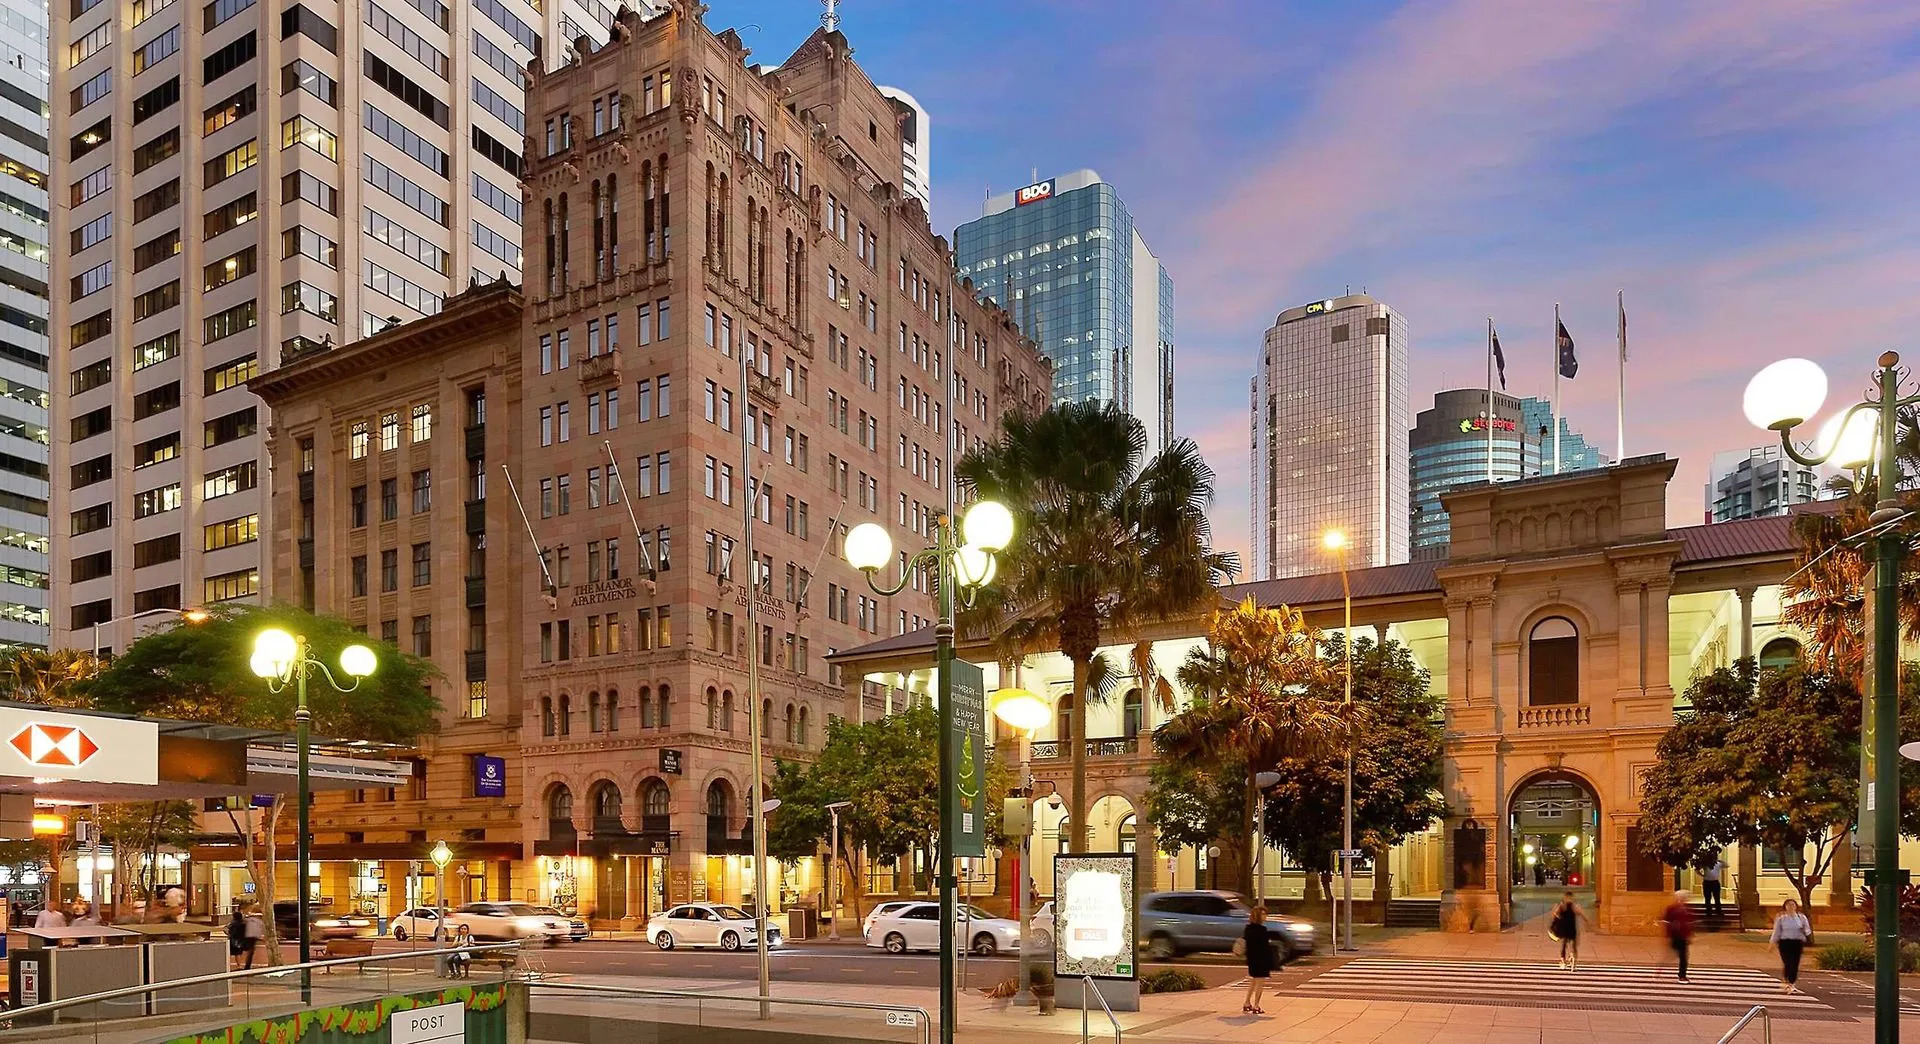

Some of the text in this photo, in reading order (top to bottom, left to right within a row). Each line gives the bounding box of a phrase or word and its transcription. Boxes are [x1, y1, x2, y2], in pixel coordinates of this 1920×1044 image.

[1022, 182, 1050, 201] BDO
[1306, 303, 1323, 314] CPA
[575, 577, 633, 595] THE MANOR
[571, 588, 637, 607] APARTMENTS
[755, 591, 784, 609] MANOR
[735, 595, 786, 620] APTMENTS
[411, 1015, 444, 1032] POST
